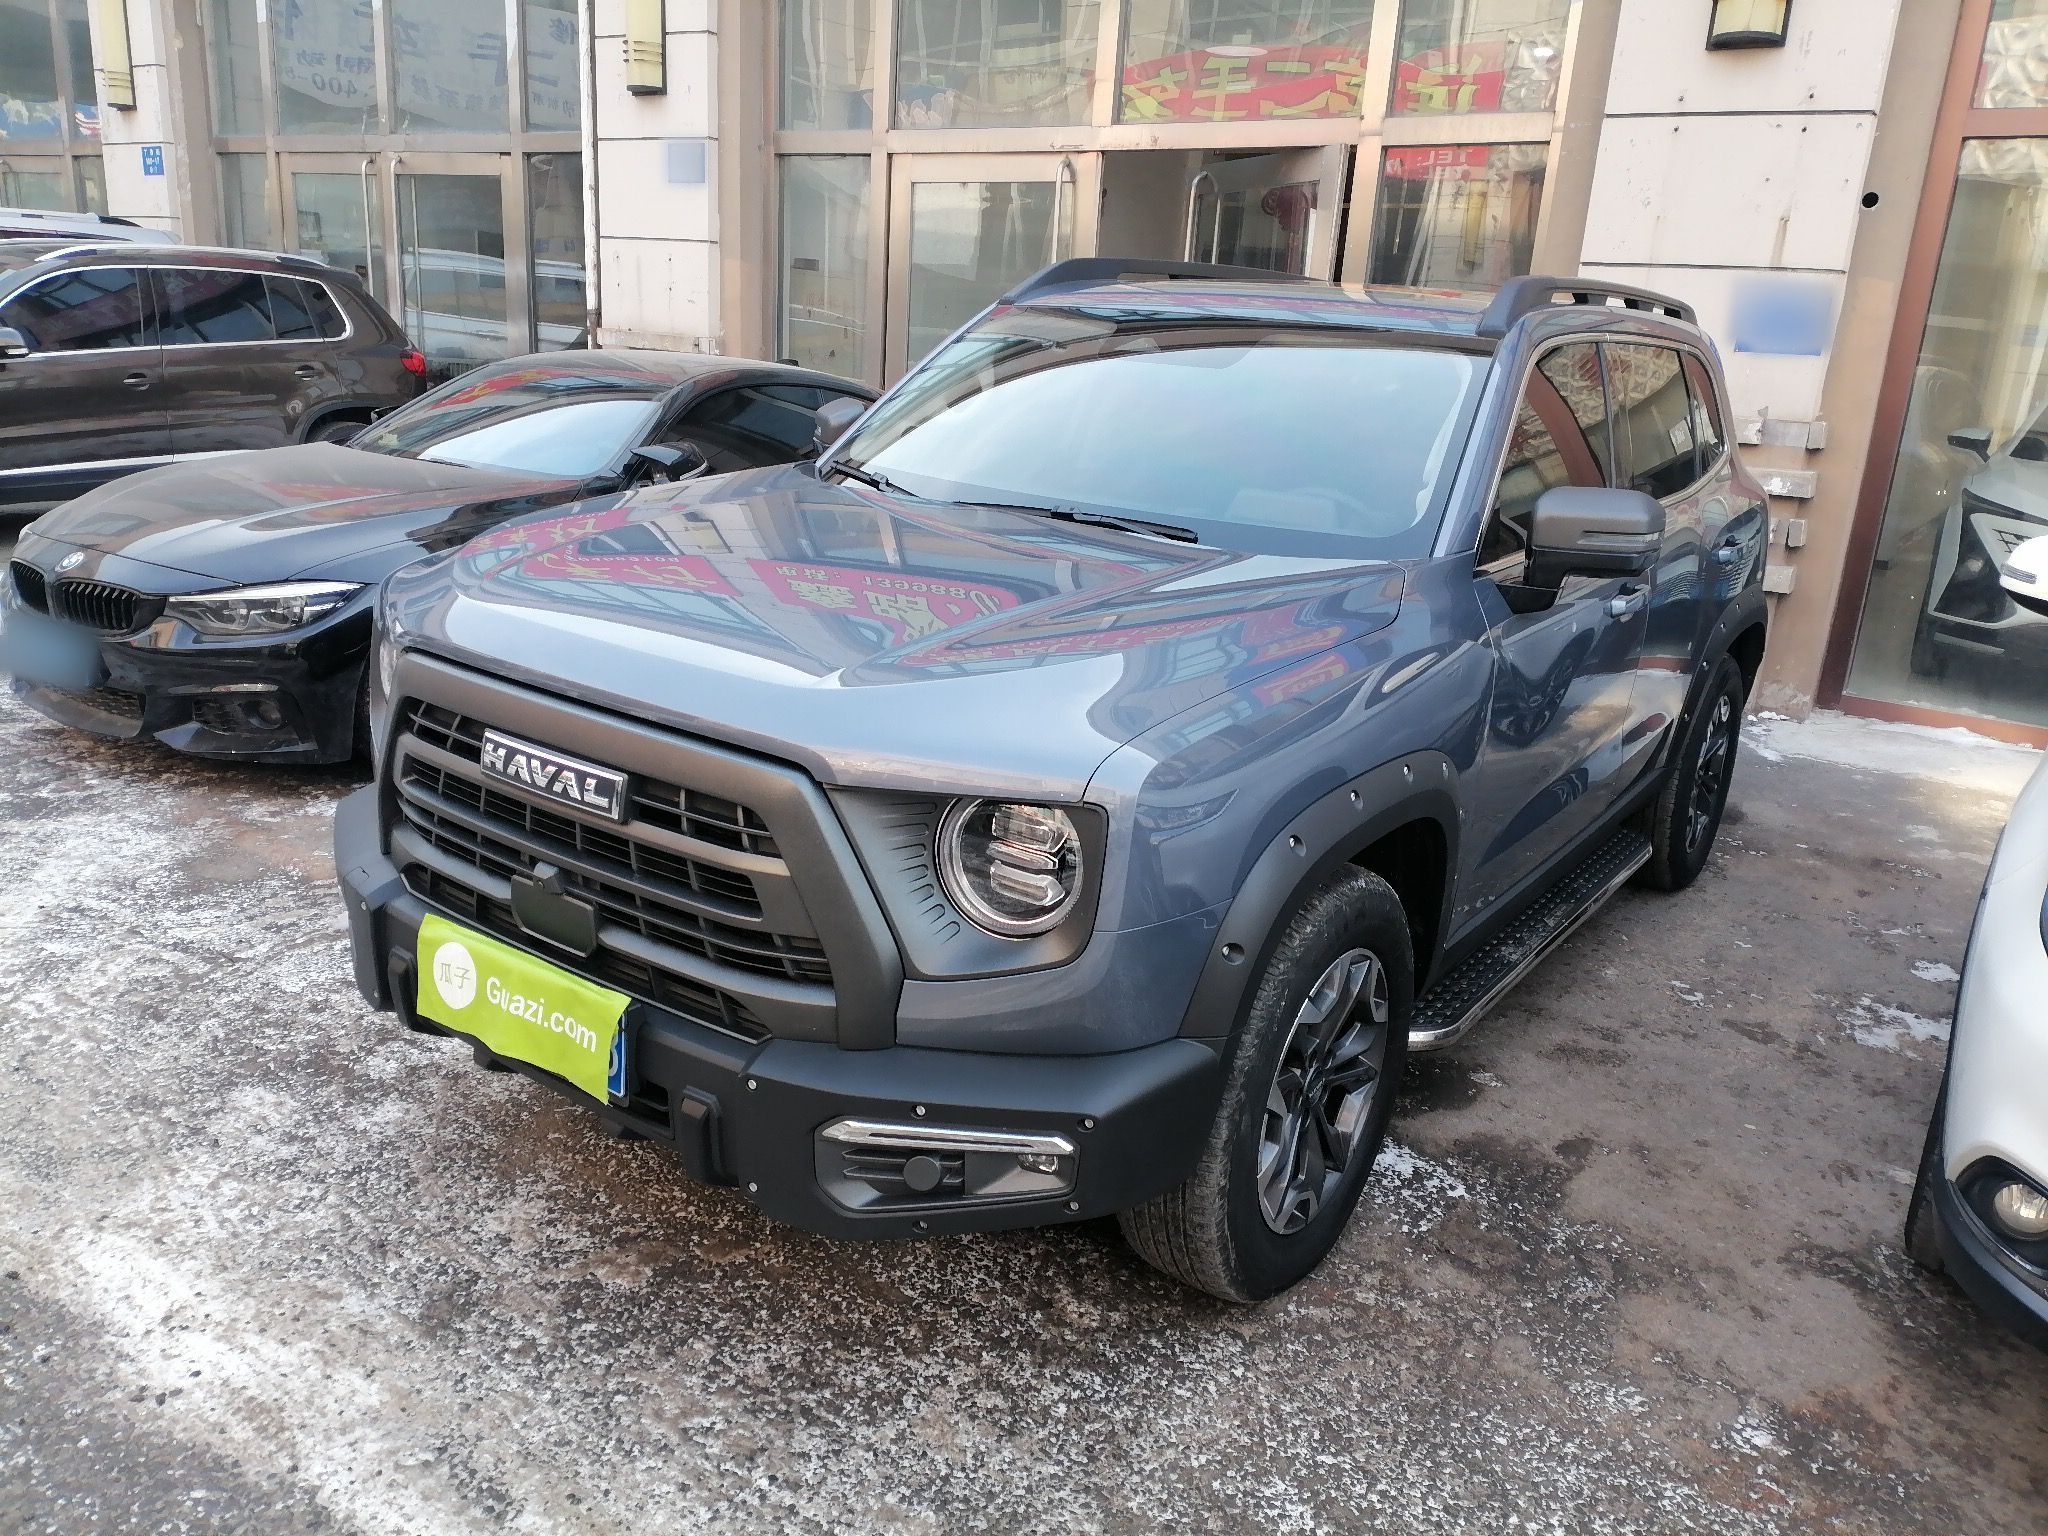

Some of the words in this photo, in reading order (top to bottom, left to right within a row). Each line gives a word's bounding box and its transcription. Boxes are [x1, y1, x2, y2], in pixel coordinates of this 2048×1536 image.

[483, 742, 610, 809] HAVAL
[438, 962, 471, 990] 瓜子
[485, 975, 597, 1053] Guazi.com
